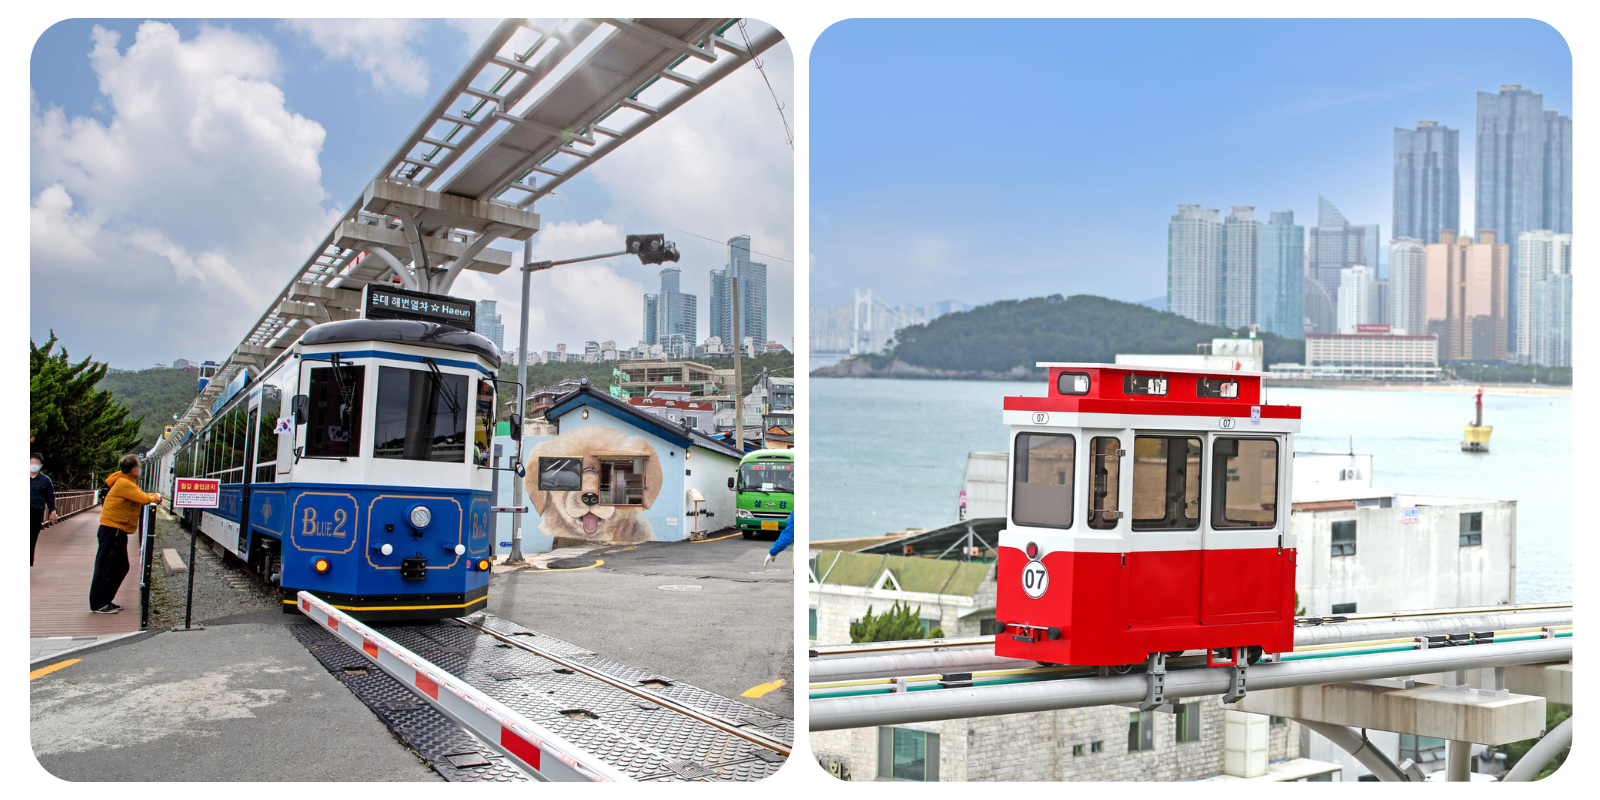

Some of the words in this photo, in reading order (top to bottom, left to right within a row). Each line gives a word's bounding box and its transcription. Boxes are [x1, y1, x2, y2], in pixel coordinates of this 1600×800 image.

[391, 296, 428, 312] 해변열차
[441, 304, 471, 317] Haeun
[1036, 413, 1045, 423] 07
[1223, 418, 1231, 428] 07
[1025, 568, 1046, 589] 07
